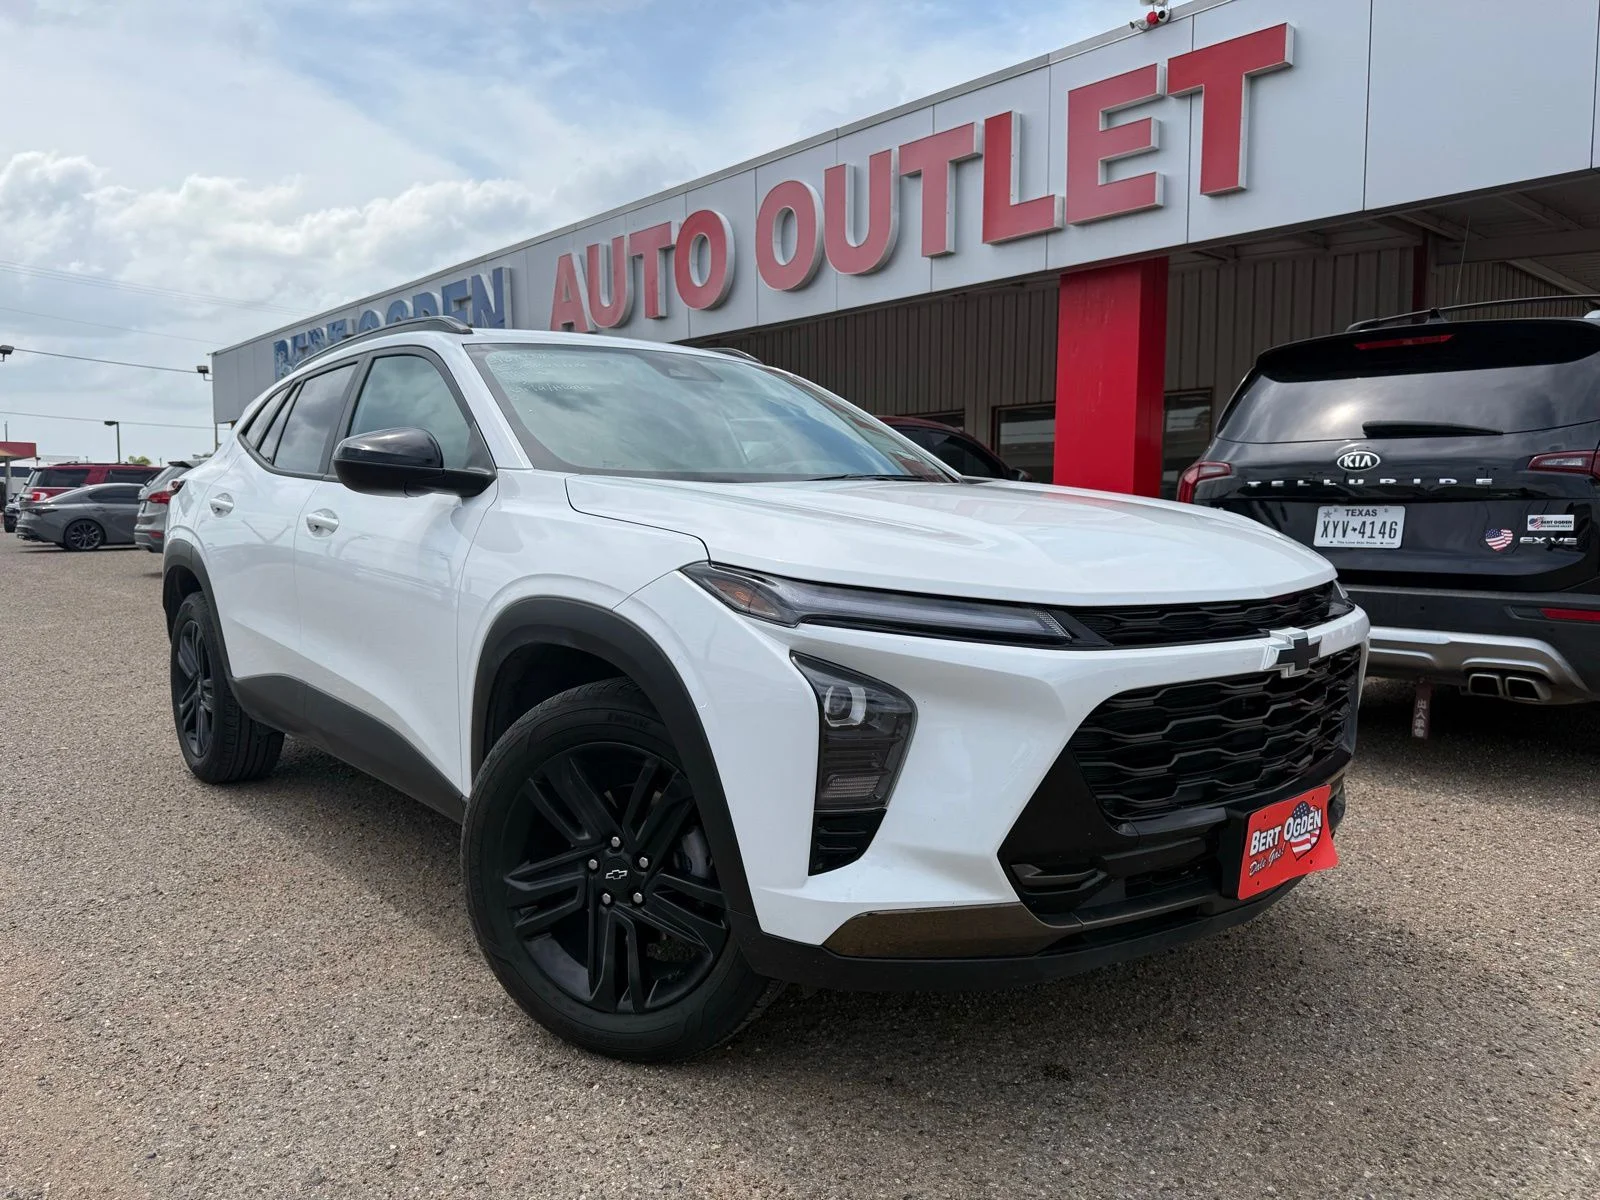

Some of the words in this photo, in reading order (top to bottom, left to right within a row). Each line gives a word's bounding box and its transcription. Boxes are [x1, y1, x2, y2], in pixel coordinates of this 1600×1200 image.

[550, 209, 735, 334] AUTO
[755, 22, 1294, 292] OUTLET
[1345, 508, 1378, 517] TEXAS
[1520, 536, 1546, 545] EX
[1249, 825, 1282, 857] BERT
[1283, 808, 1322, 841] OGDEN
